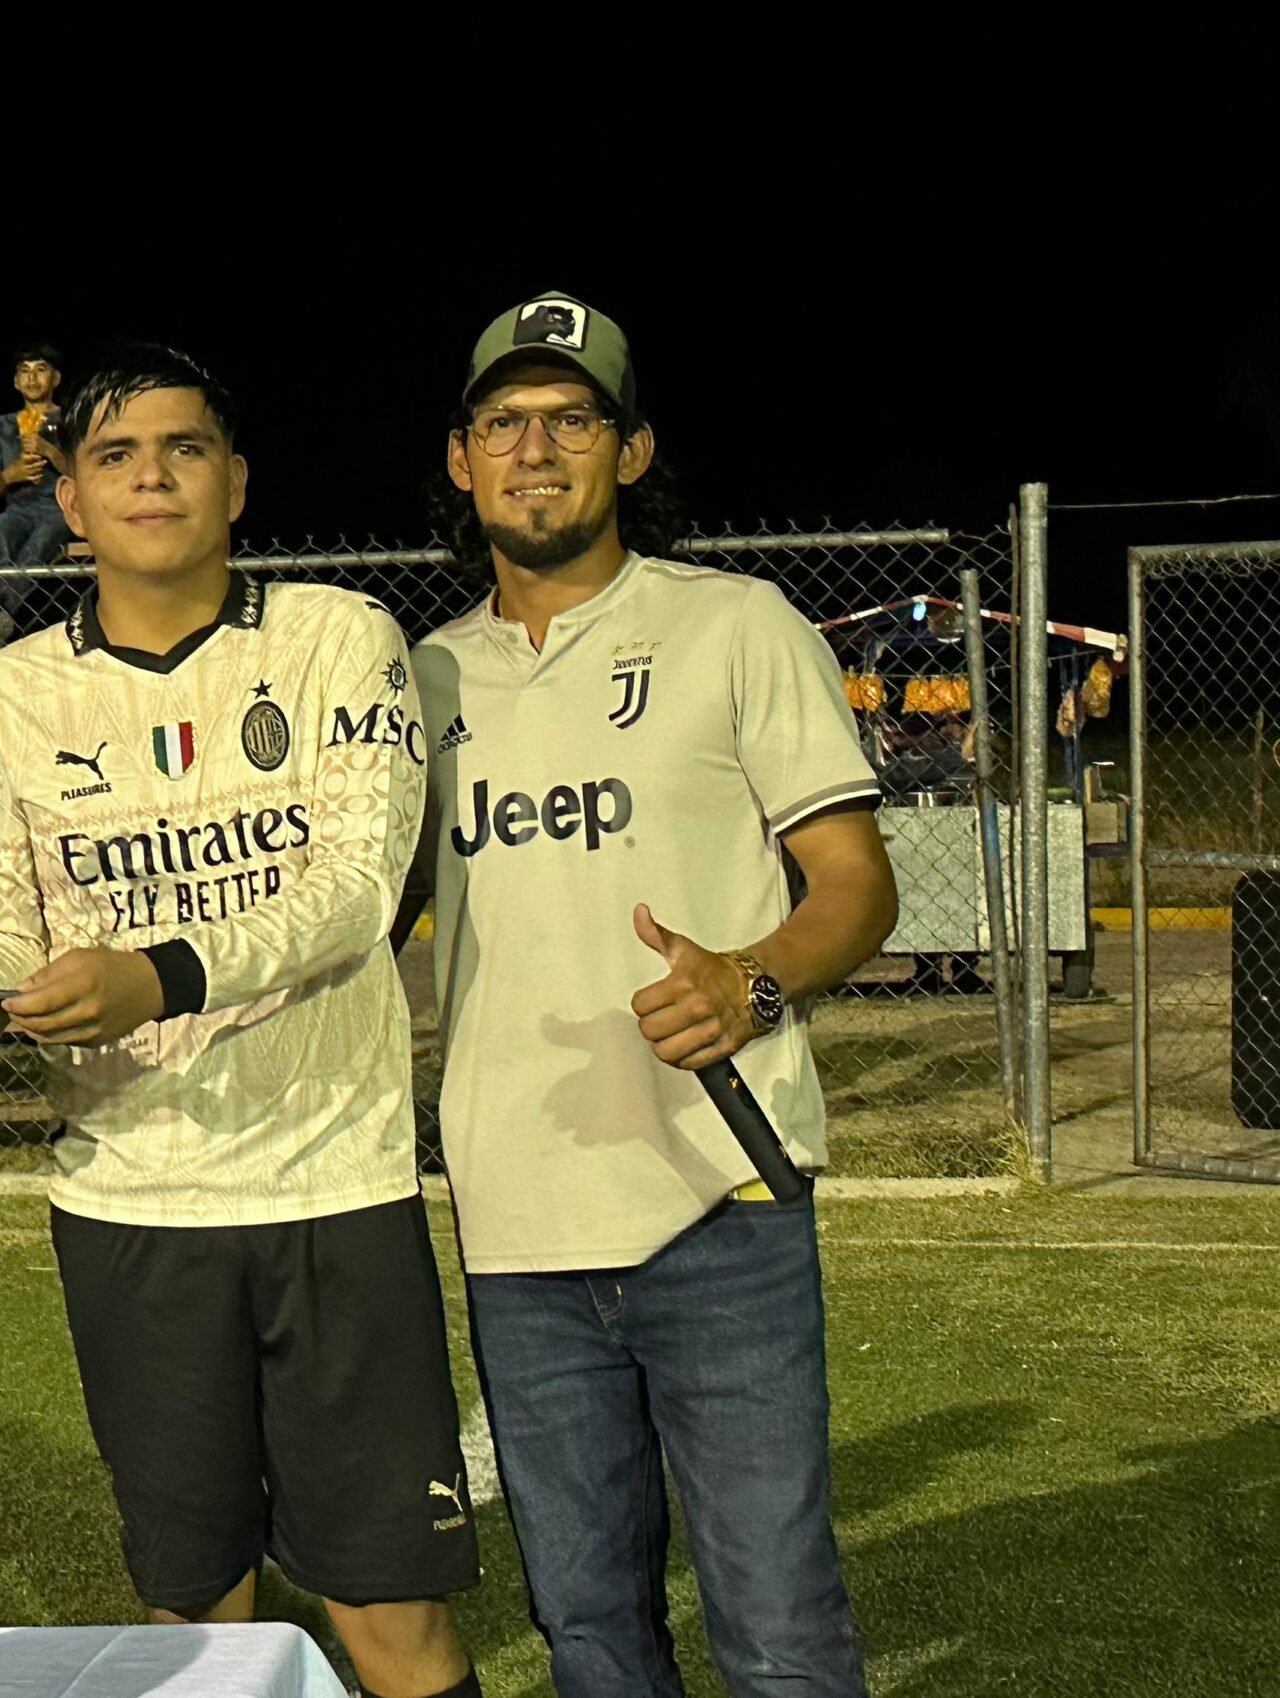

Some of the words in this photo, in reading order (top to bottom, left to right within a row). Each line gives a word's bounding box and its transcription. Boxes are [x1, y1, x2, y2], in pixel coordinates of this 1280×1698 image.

[325, 703, 425, 766] MSC
[57, 803, 310, 887] Emirates
[451, 777, 633, 857] Jeep
